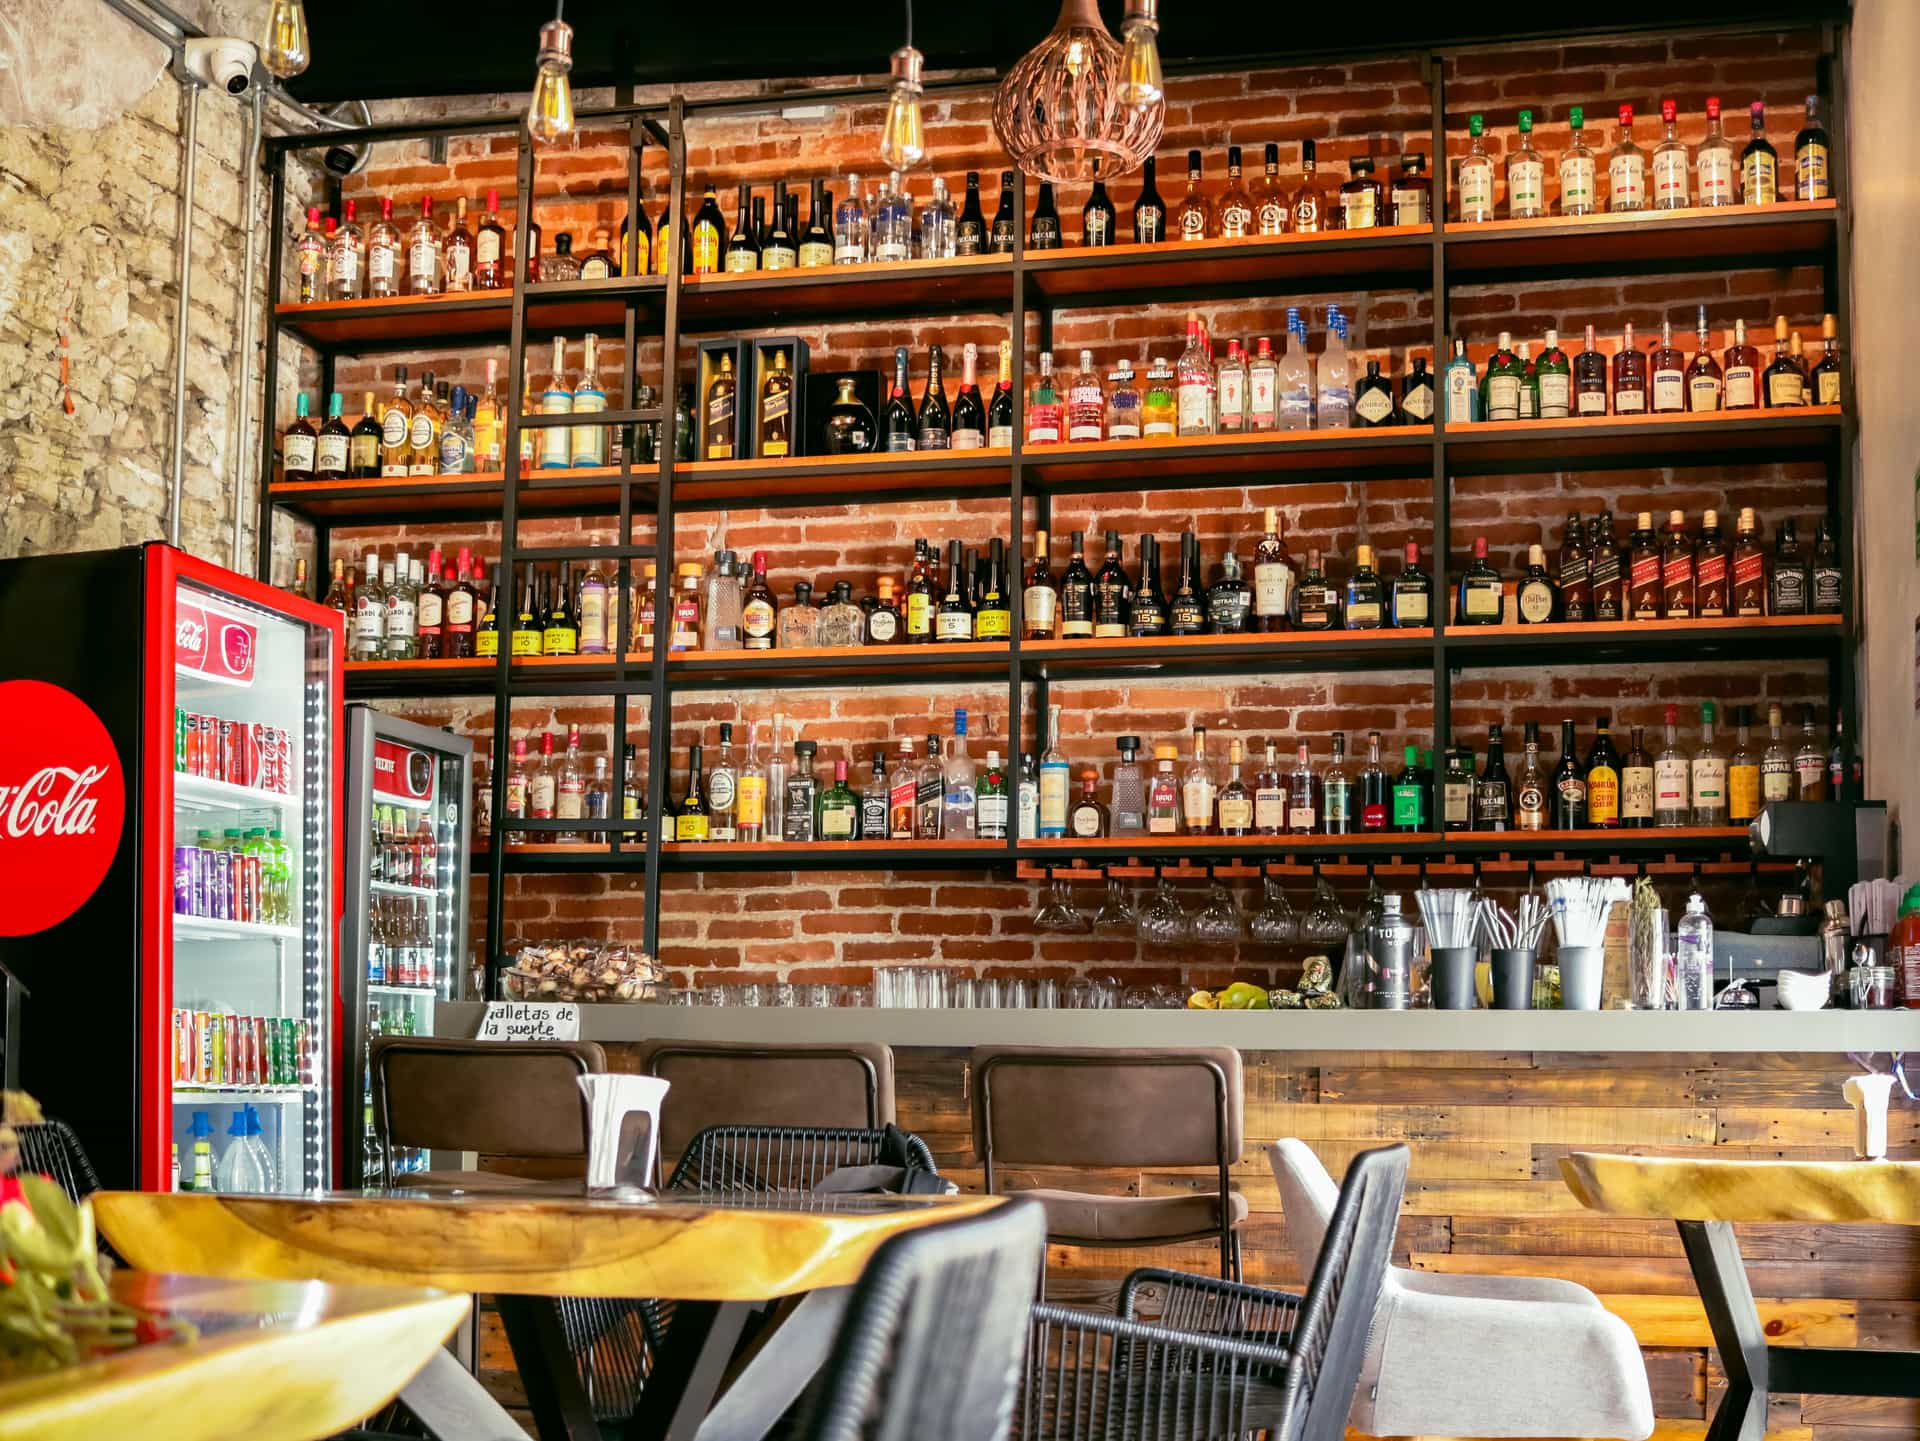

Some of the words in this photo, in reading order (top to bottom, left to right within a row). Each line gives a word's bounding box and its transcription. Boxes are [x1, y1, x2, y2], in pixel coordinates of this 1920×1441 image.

[678, 609, 695, 617] 1800
[1178, 613, 1191, 622] 15
[1137, 614, 1150, 623] 15
[1760, 762, 1791, 773] CAMPARI
[685, 824, 695, 832] 10
[556, 1008, 574, 1021] de
[485, 1020, 498, 1036] la
[507, 1021, 554, 1036] suerte
